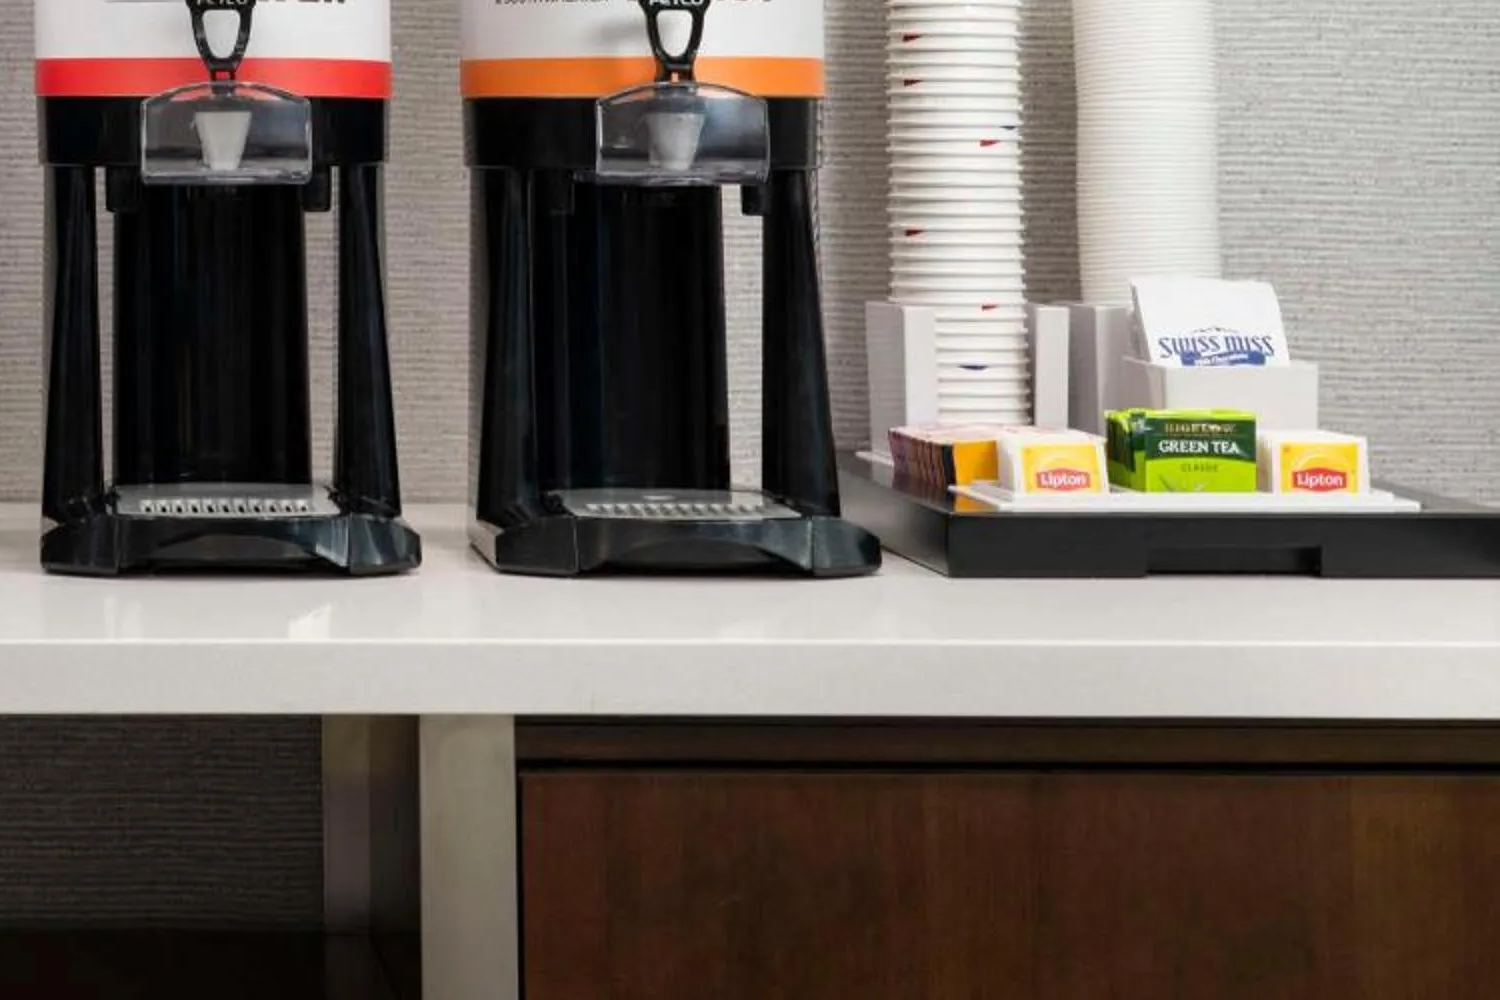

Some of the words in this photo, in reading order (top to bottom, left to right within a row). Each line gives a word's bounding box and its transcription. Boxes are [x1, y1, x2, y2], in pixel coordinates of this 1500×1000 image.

[1158, 439, 1209, 453] GREEN
[1211, 441, 1240, 455] TEA
[1041, 473, 1087, 488] Lipton
[1297, 471, 1344, 489] Lipton
